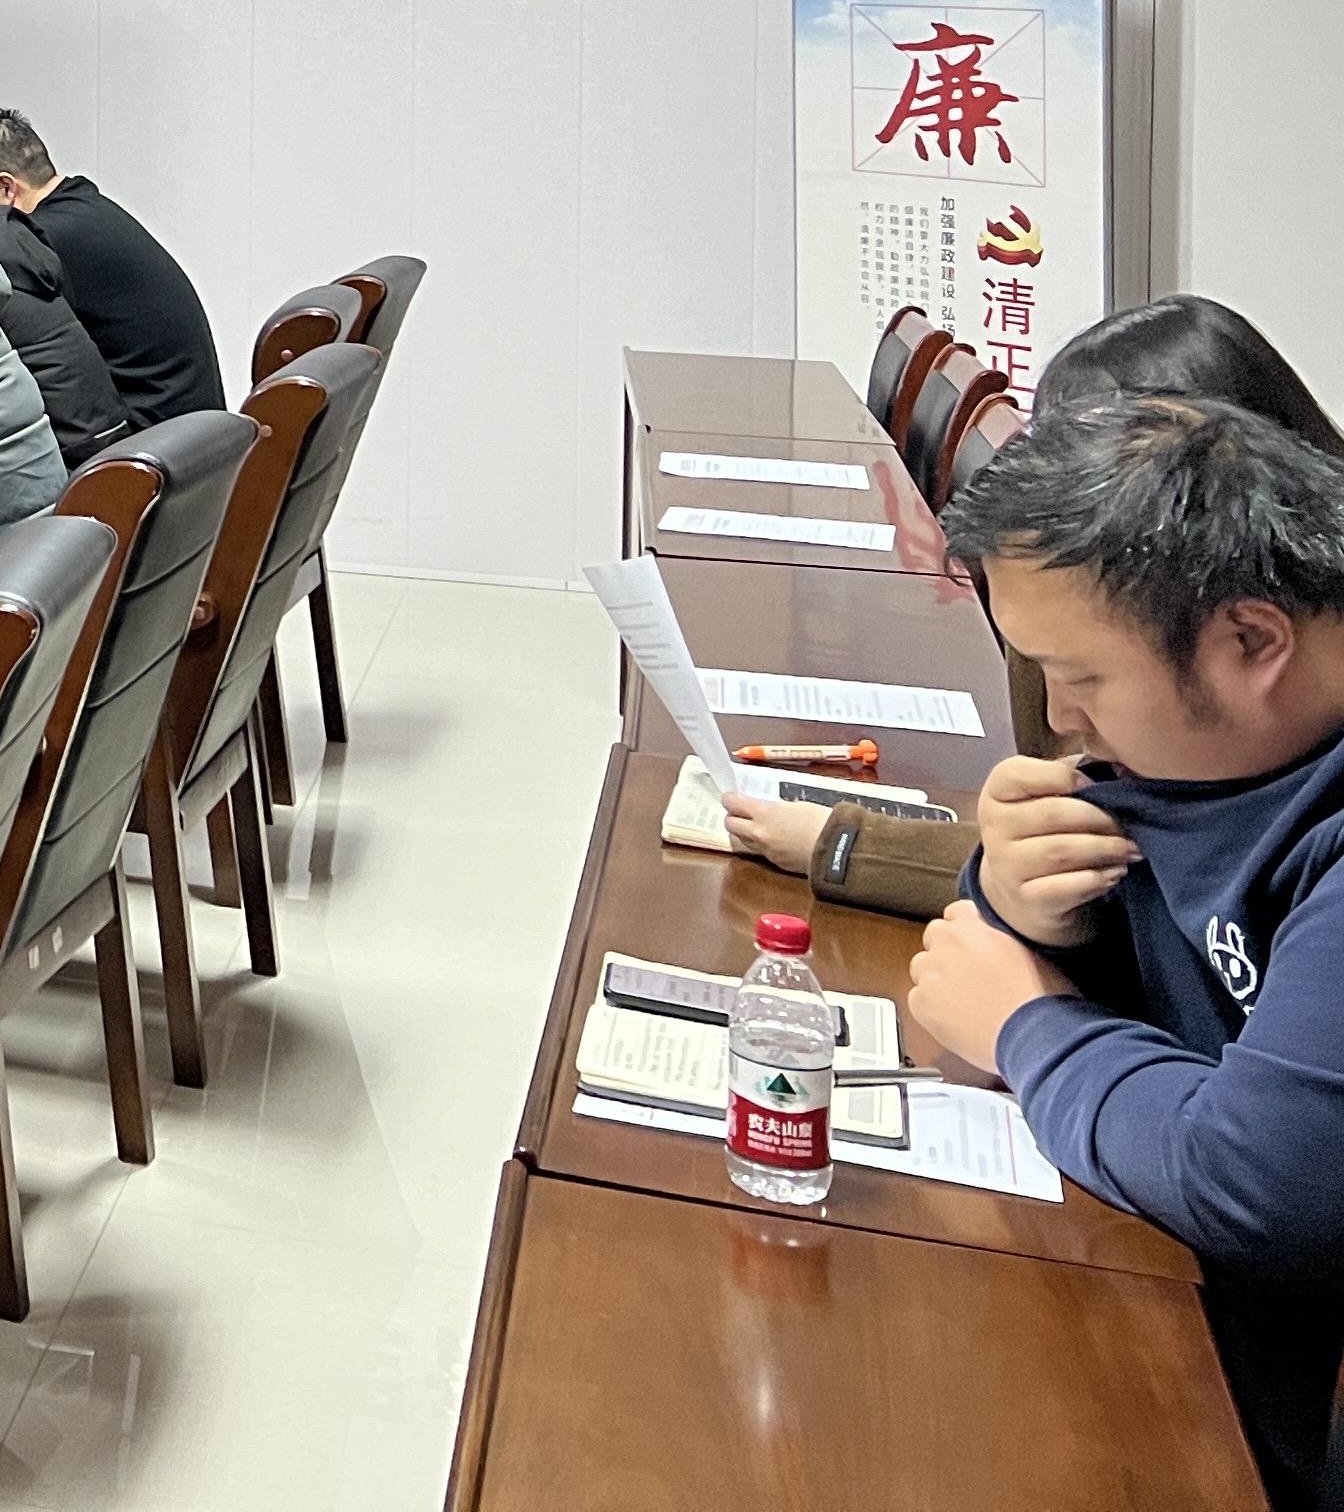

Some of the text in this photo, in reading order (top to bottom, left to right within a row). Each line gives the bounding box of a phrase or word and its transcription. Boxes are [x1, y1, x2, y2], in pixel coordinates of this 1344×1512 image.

[875, 22, 1020, 166] 廉
[940, 196, 956, 299] 加强廉政建设
[982, 277, 1036, 393] 清正
